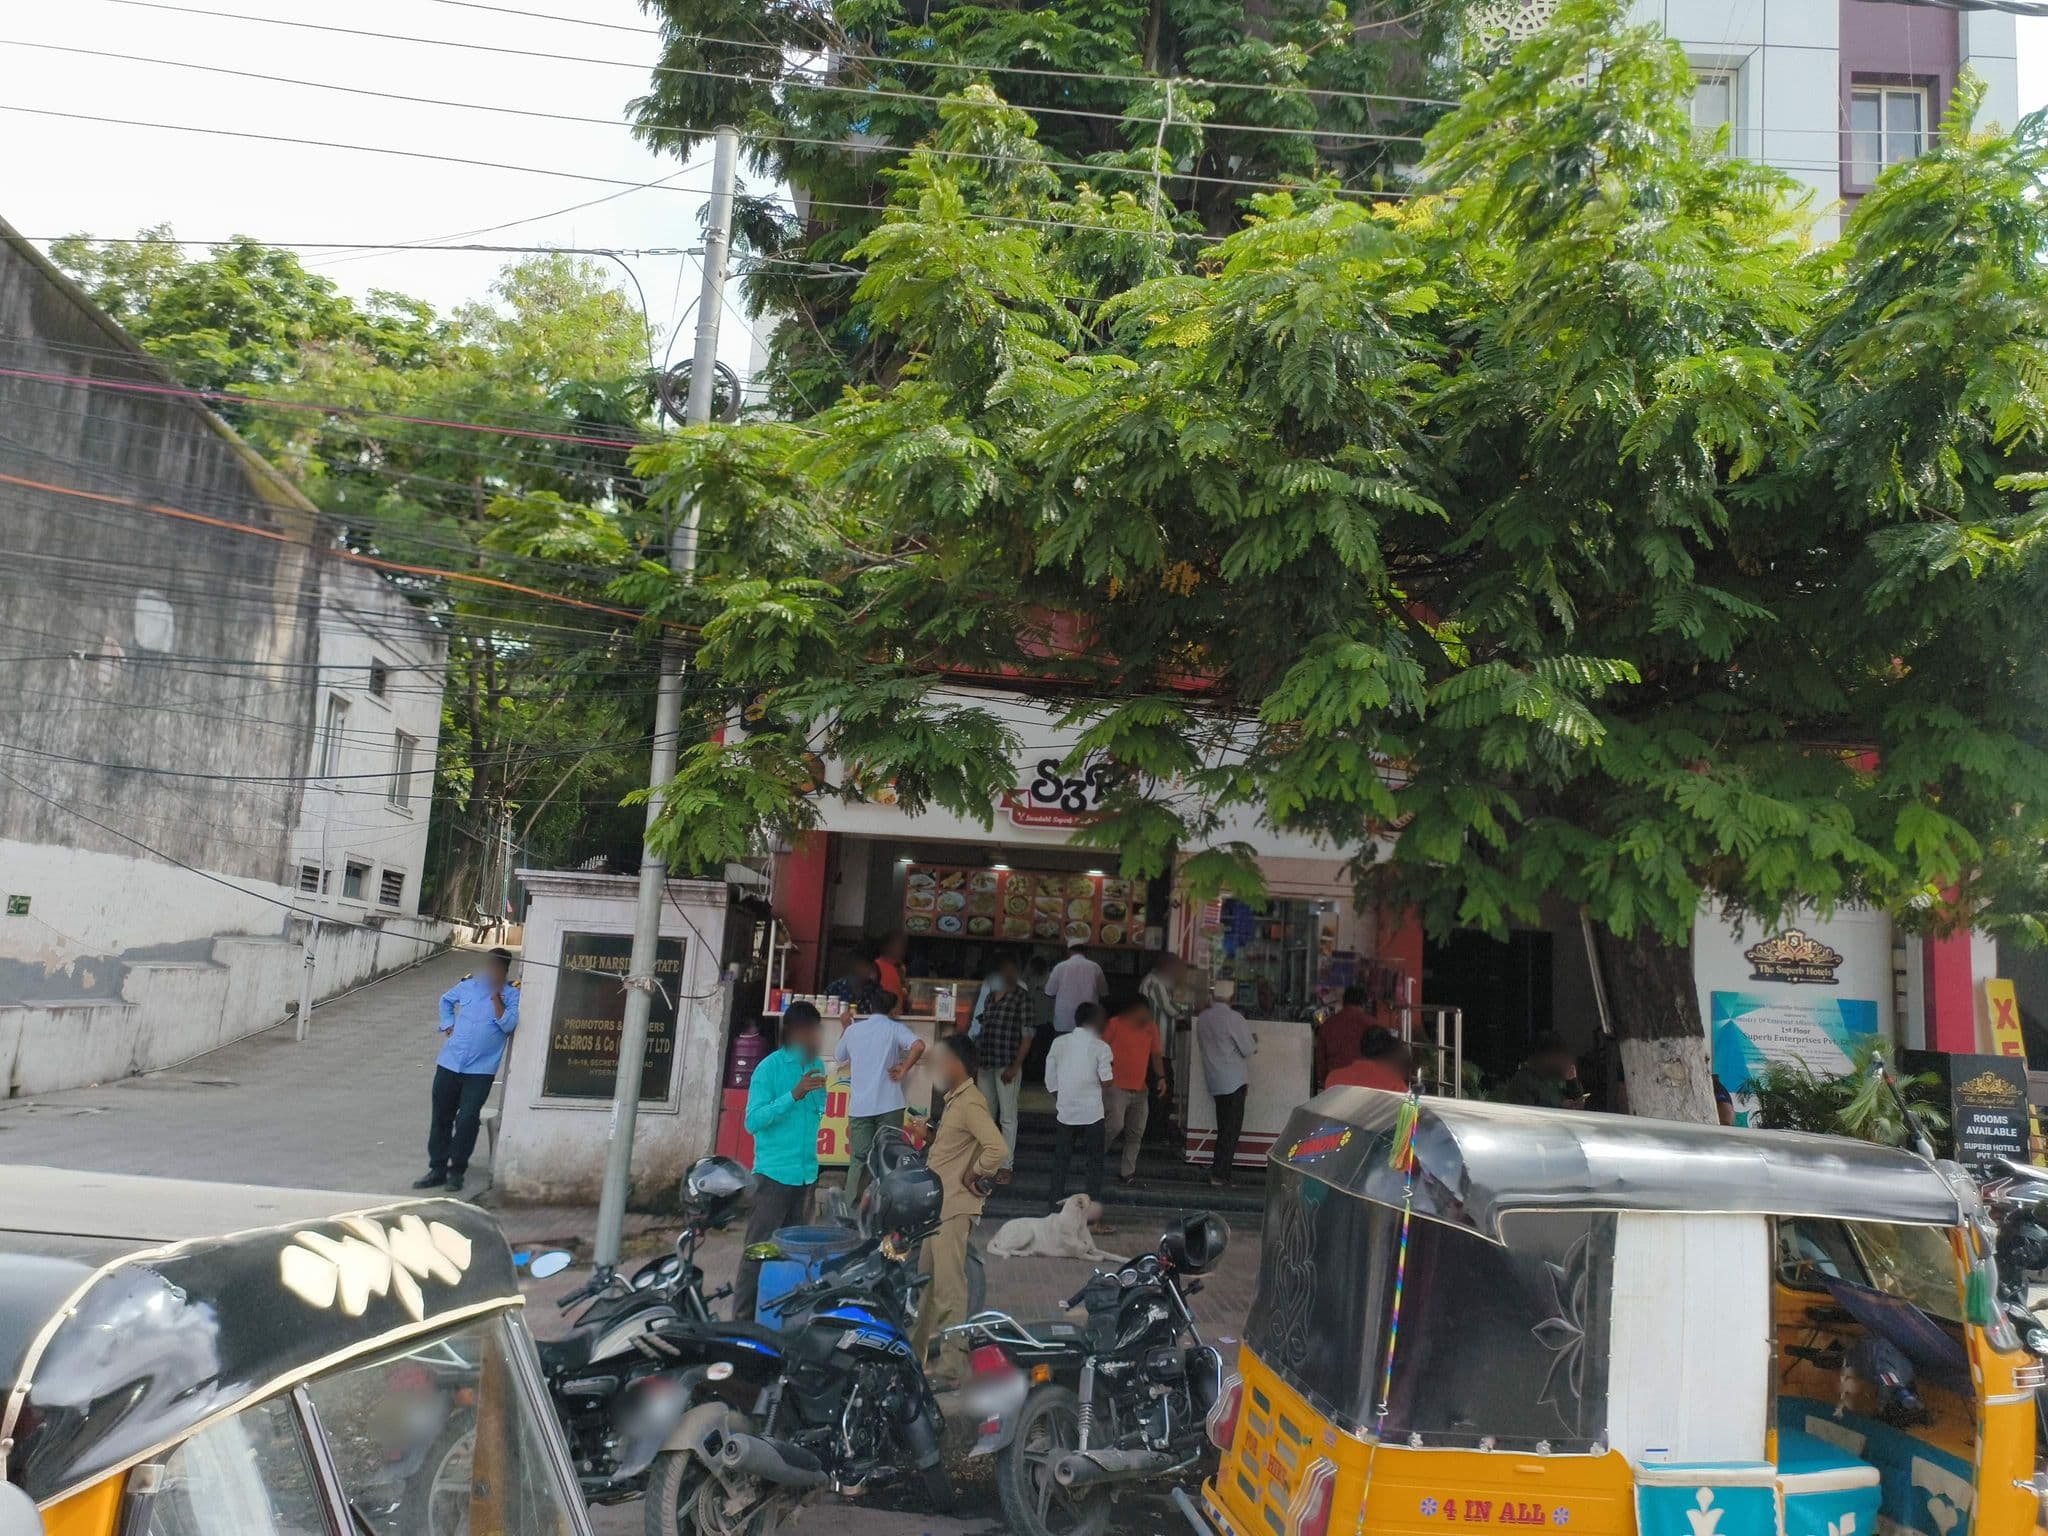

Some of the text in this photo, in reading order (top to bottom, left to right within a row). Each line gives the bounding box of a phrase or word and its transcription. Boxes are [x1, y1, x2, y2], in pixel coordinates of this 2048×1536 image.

[565, 955, 680, 973] LAXMI NARSI TATE
[1758, 964, 1832, 978] The Superb Hotels
[564, 1019, 615, 1031] PROMOTORS
[1781, 1026, 1811, 1035] 1st Floor
[554, 1034, 594, 1051] C.S.BROS
[603, 1037, 614, 1052] Co
[1743, 1032, 1773, 1043] Superb
[1774, 1035, 1822, 1046] Enterprises
[1973, 1114, 2009, 1125] ROOMS
[1966, 1125, 2018, 1137] AVAILABLE
[1963, 1142, 2021, 1152] SUPERB HOTELS
[1442, 1498, 1547, 1526] 4 IN ALL
